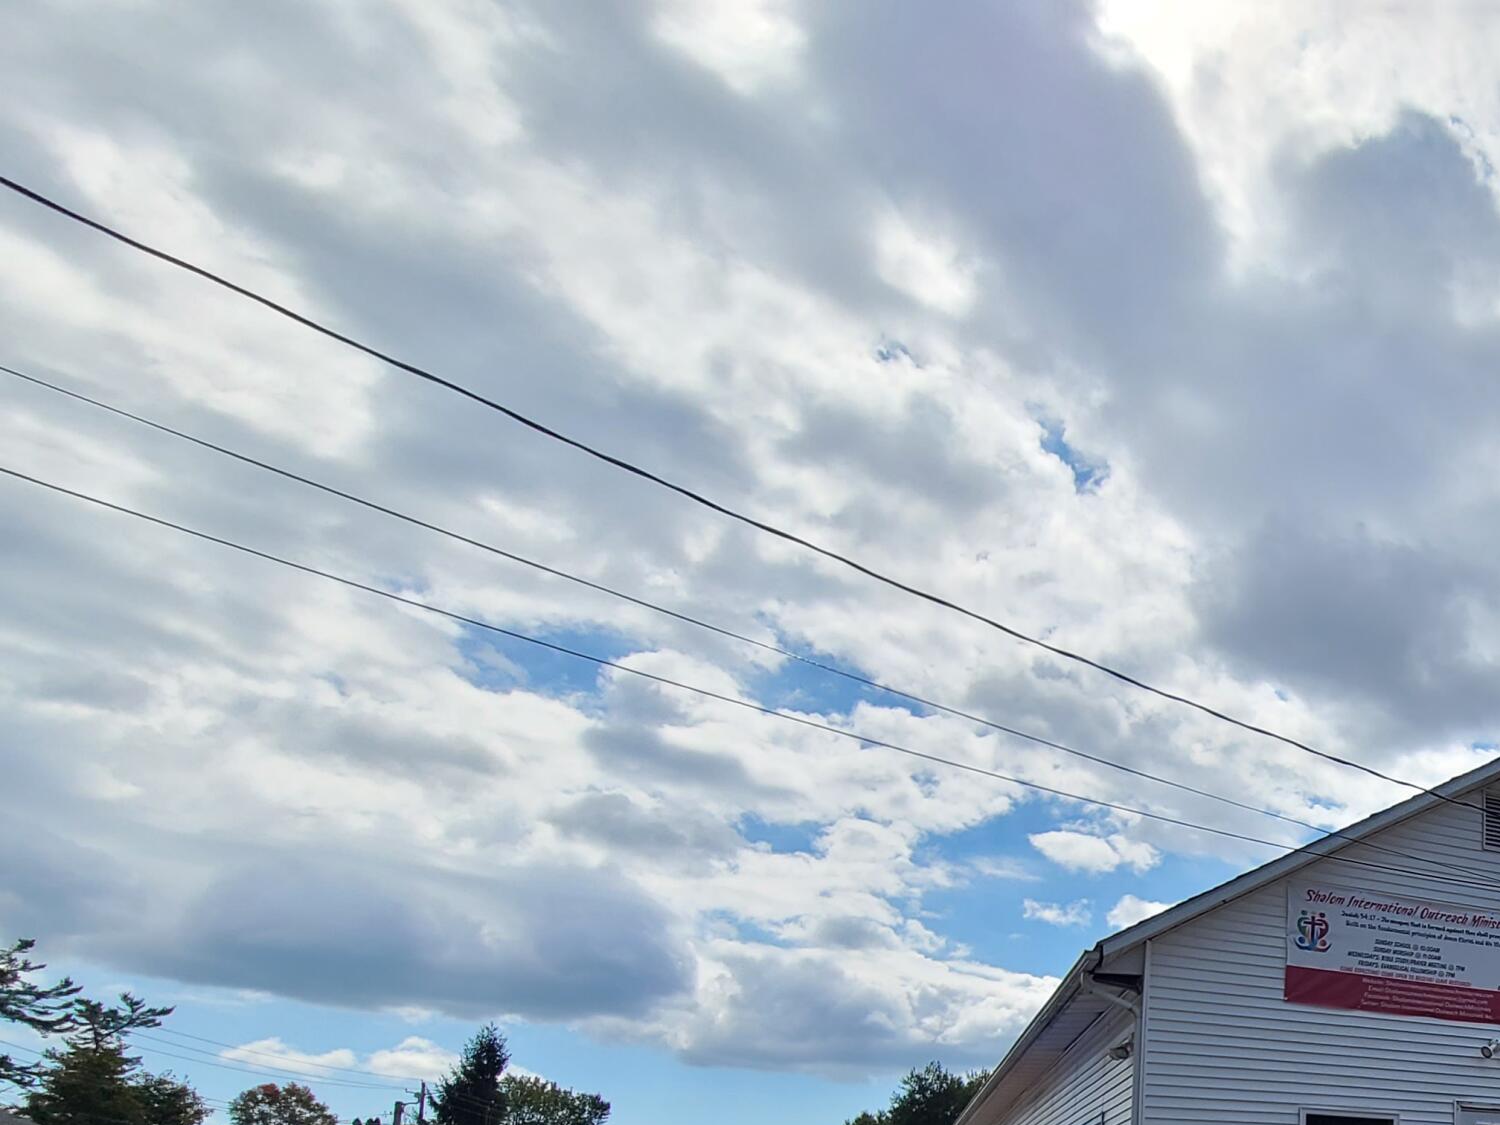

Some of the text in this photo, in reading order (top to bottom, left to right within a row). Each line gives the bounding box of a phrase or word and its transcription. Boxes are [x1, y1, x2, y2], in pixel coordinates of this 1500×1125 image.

[1305, 889, 1346, 905] Shalom
[1347, 895, 1421, 917] International
[1420, 907, 1469, 925] Outreach
